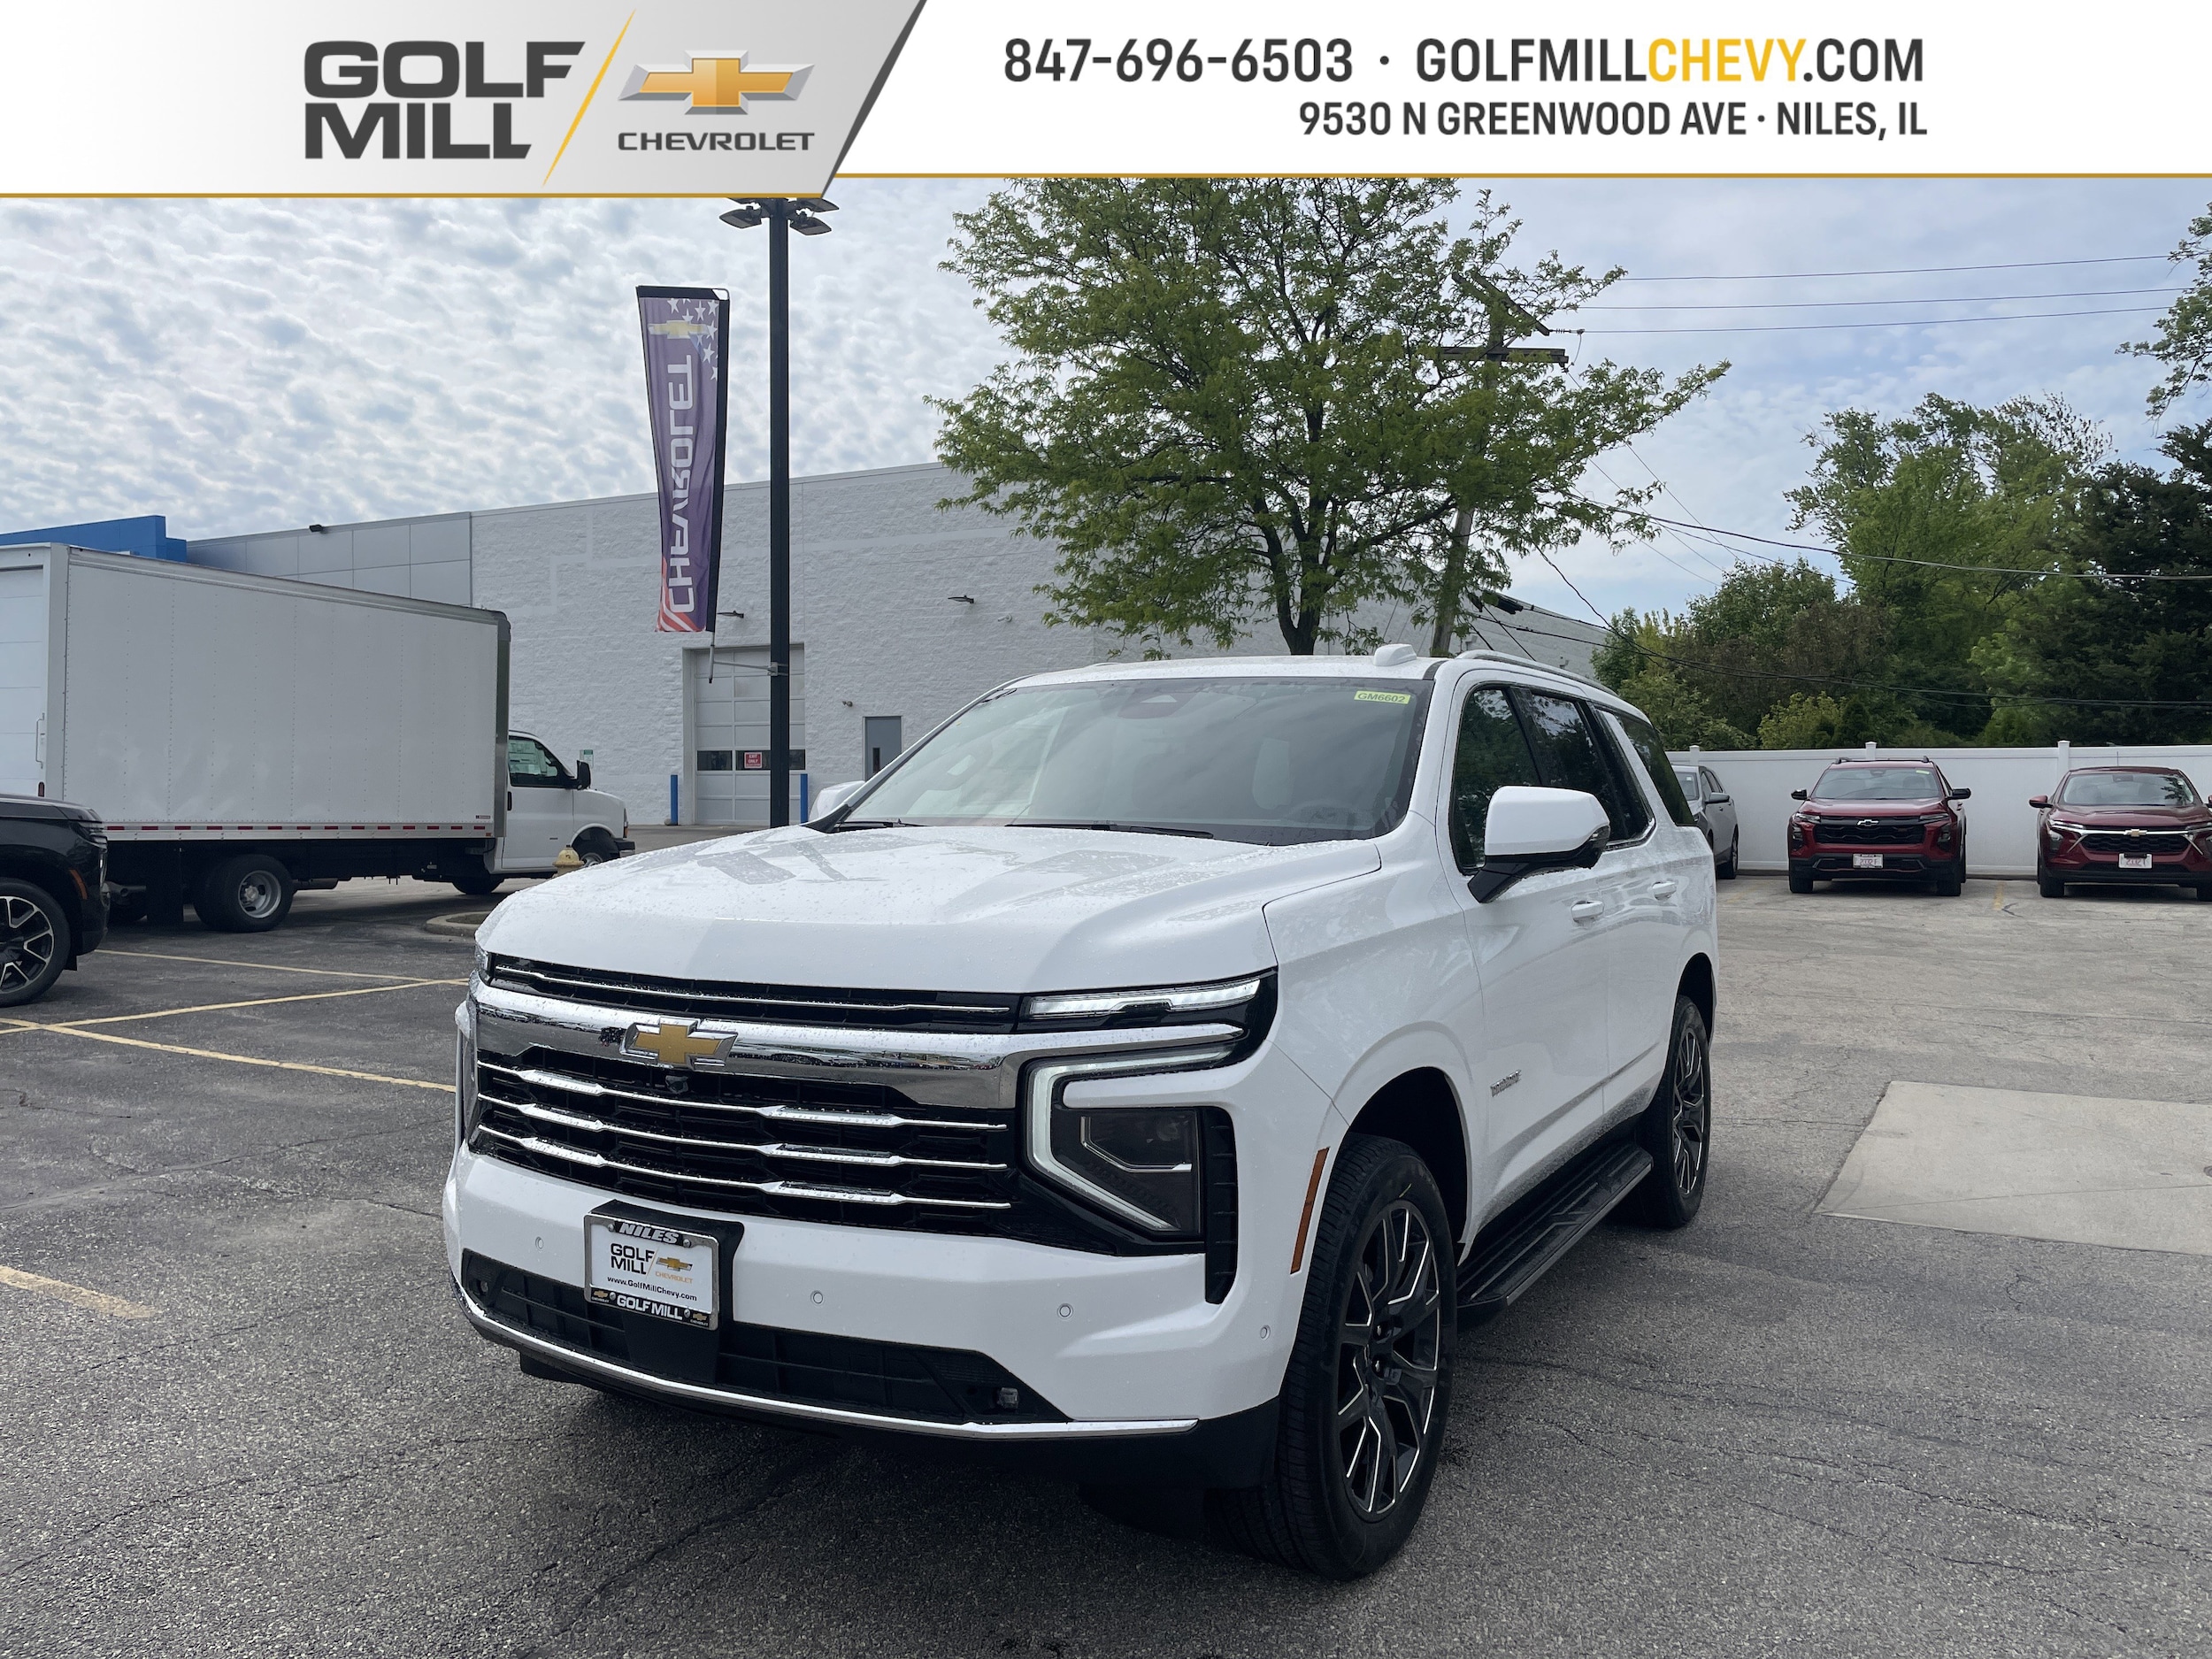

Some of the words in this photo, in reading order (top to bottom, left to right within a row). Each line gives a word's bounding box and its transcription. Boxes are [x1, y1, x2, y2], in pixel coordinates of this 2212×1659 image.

[1357, 693, 1406, 703] GM6602
[619, 1222, 679, 1244] NILES
[611, 1243, 655, 1263] GOLF
[611, 1256, 647, 1275] MILL
[655, 1271, 693, 1284] CHEVROLET
[607, 1277, 697, 1302] www.GolfMillChevy.com
[617, 1294, 651, 1312] GOLF
[650, 1302, 683, 1320] MILL
